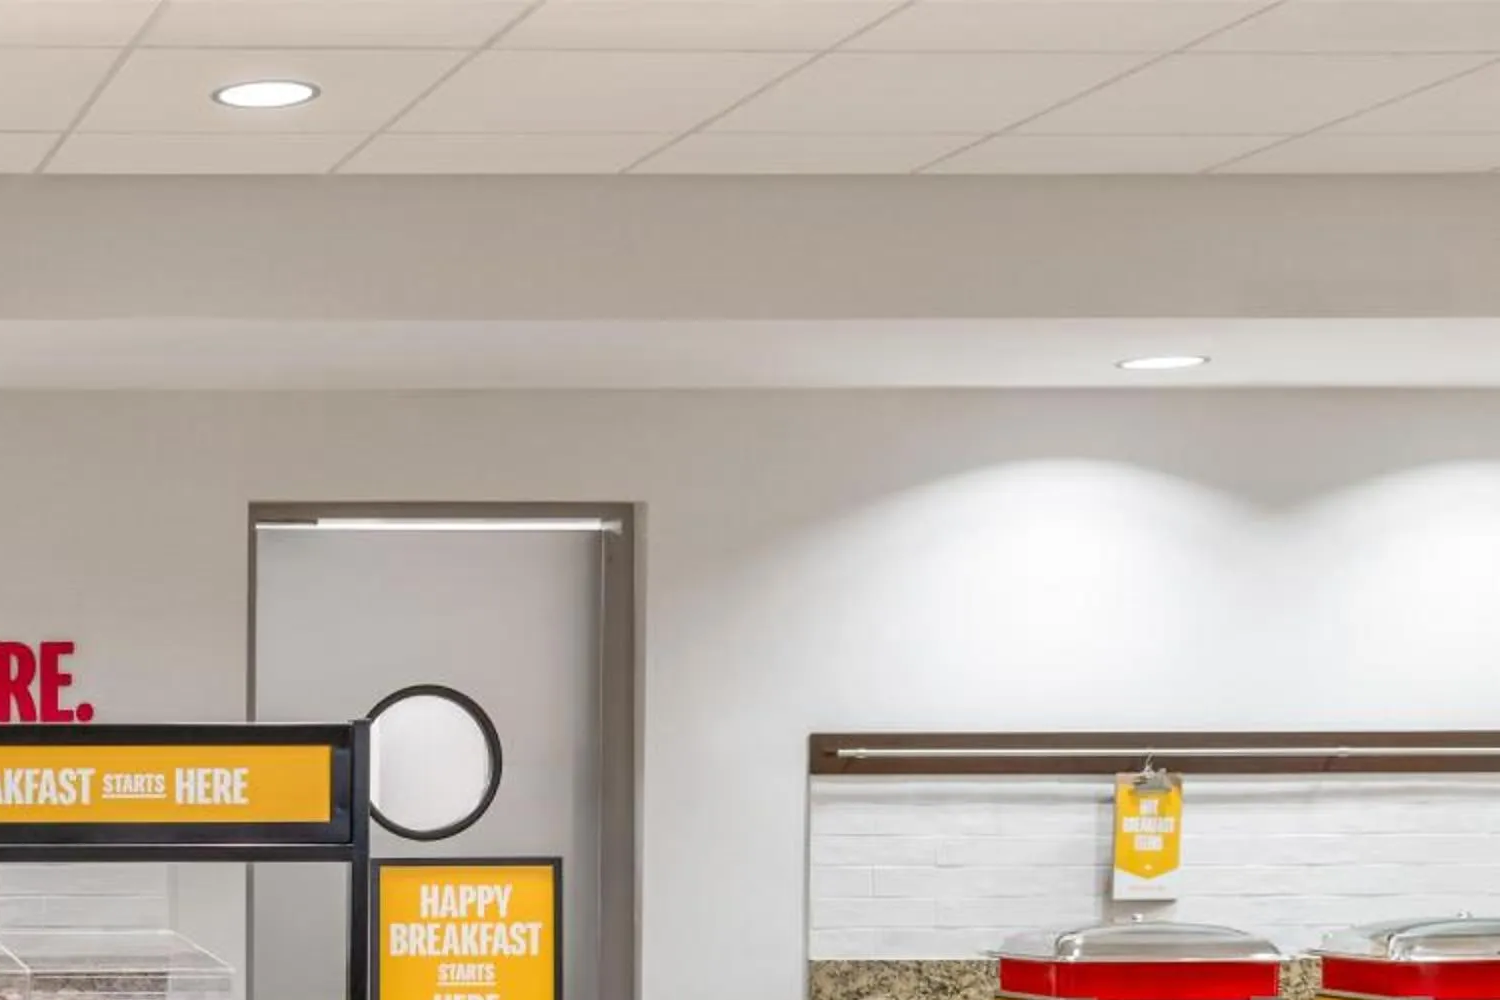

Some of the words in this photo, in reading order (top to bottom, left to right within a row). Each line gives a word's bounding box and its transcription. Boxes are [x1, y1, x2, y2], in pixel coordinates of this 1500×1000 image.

[103, 775, 166, 793] STARTS
[175, 768, 249, 805] HERE
[420, 884, 512, 918] HAPPY
[389, 922, 543, 956] BREAKFAST
[438, 963, 495, 982] STARTS
